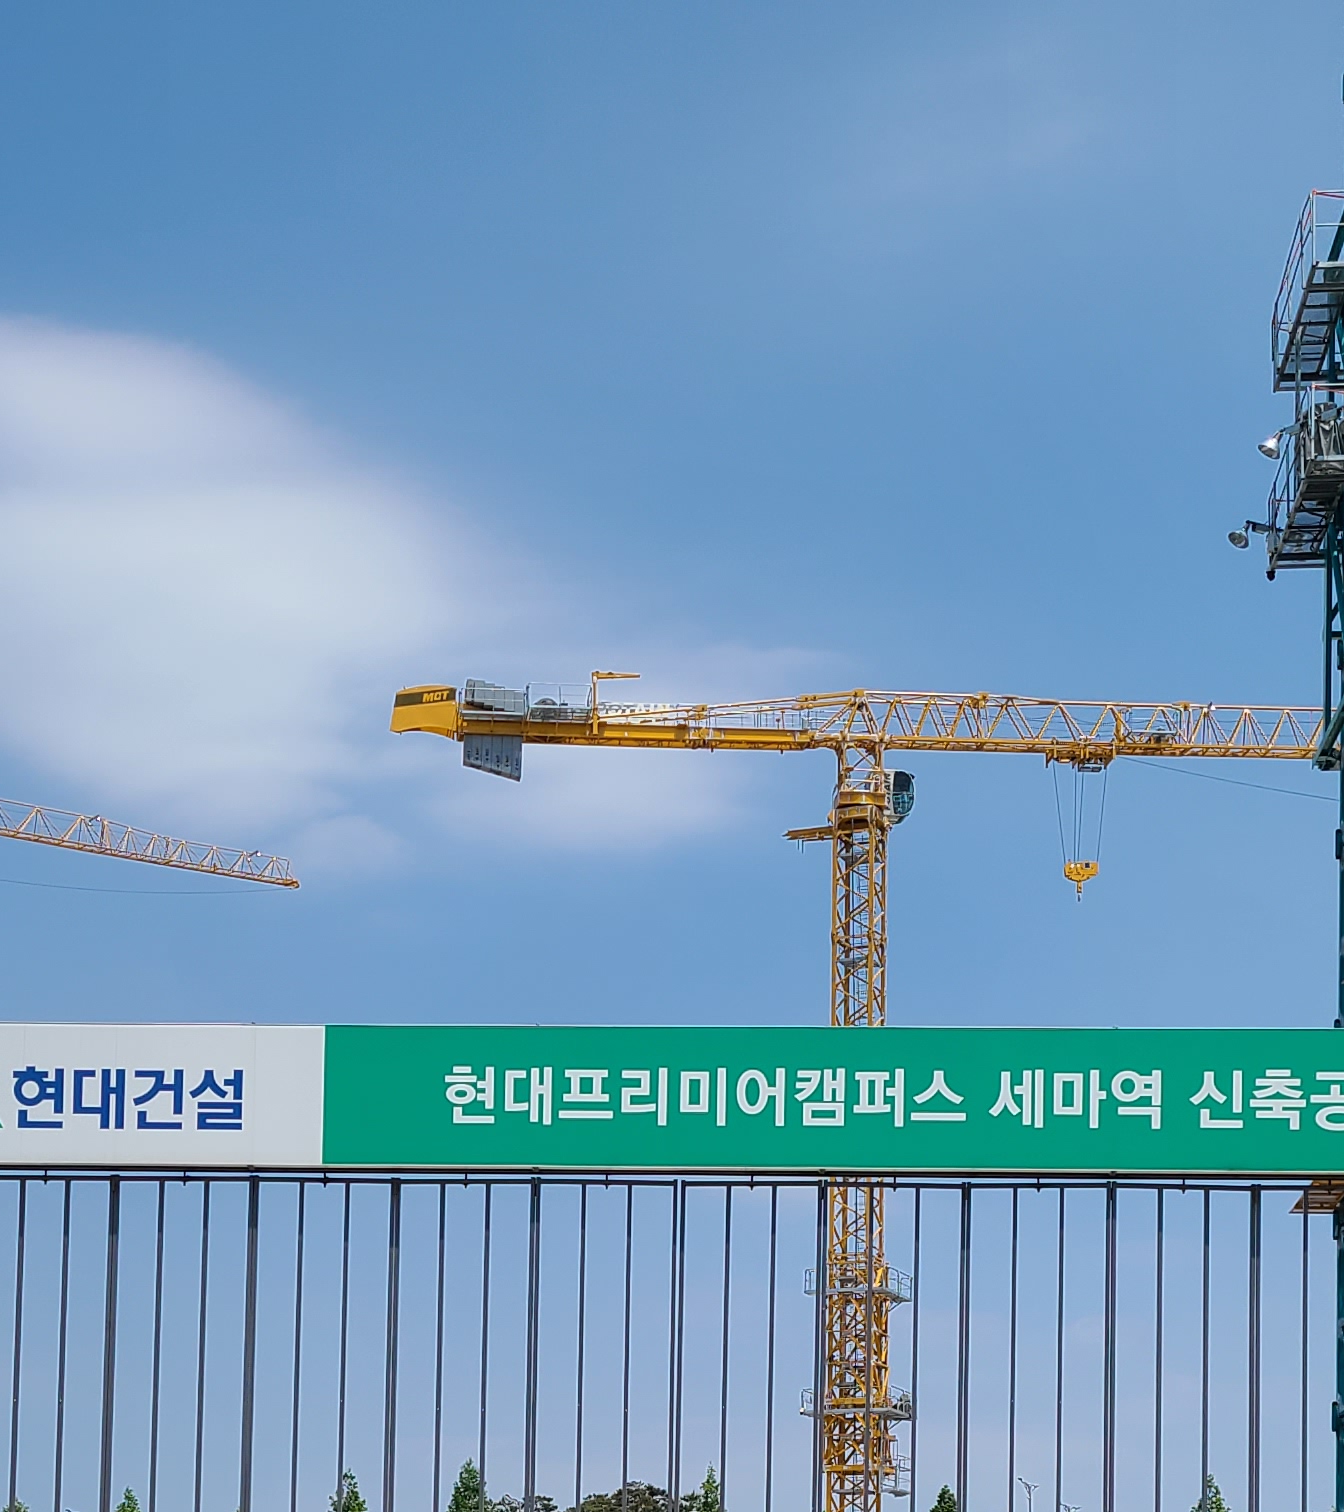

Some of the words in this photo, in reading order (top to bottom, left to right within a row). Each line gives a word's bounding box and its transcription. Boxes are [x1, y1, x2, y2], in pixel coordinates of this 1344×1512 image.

[12, 1065, 245, 1131] 현대건설
[444, 1065, 967, 1127] 현대프리미어캠퍼스
[989, 1068, 1163, 1132] 세마역
